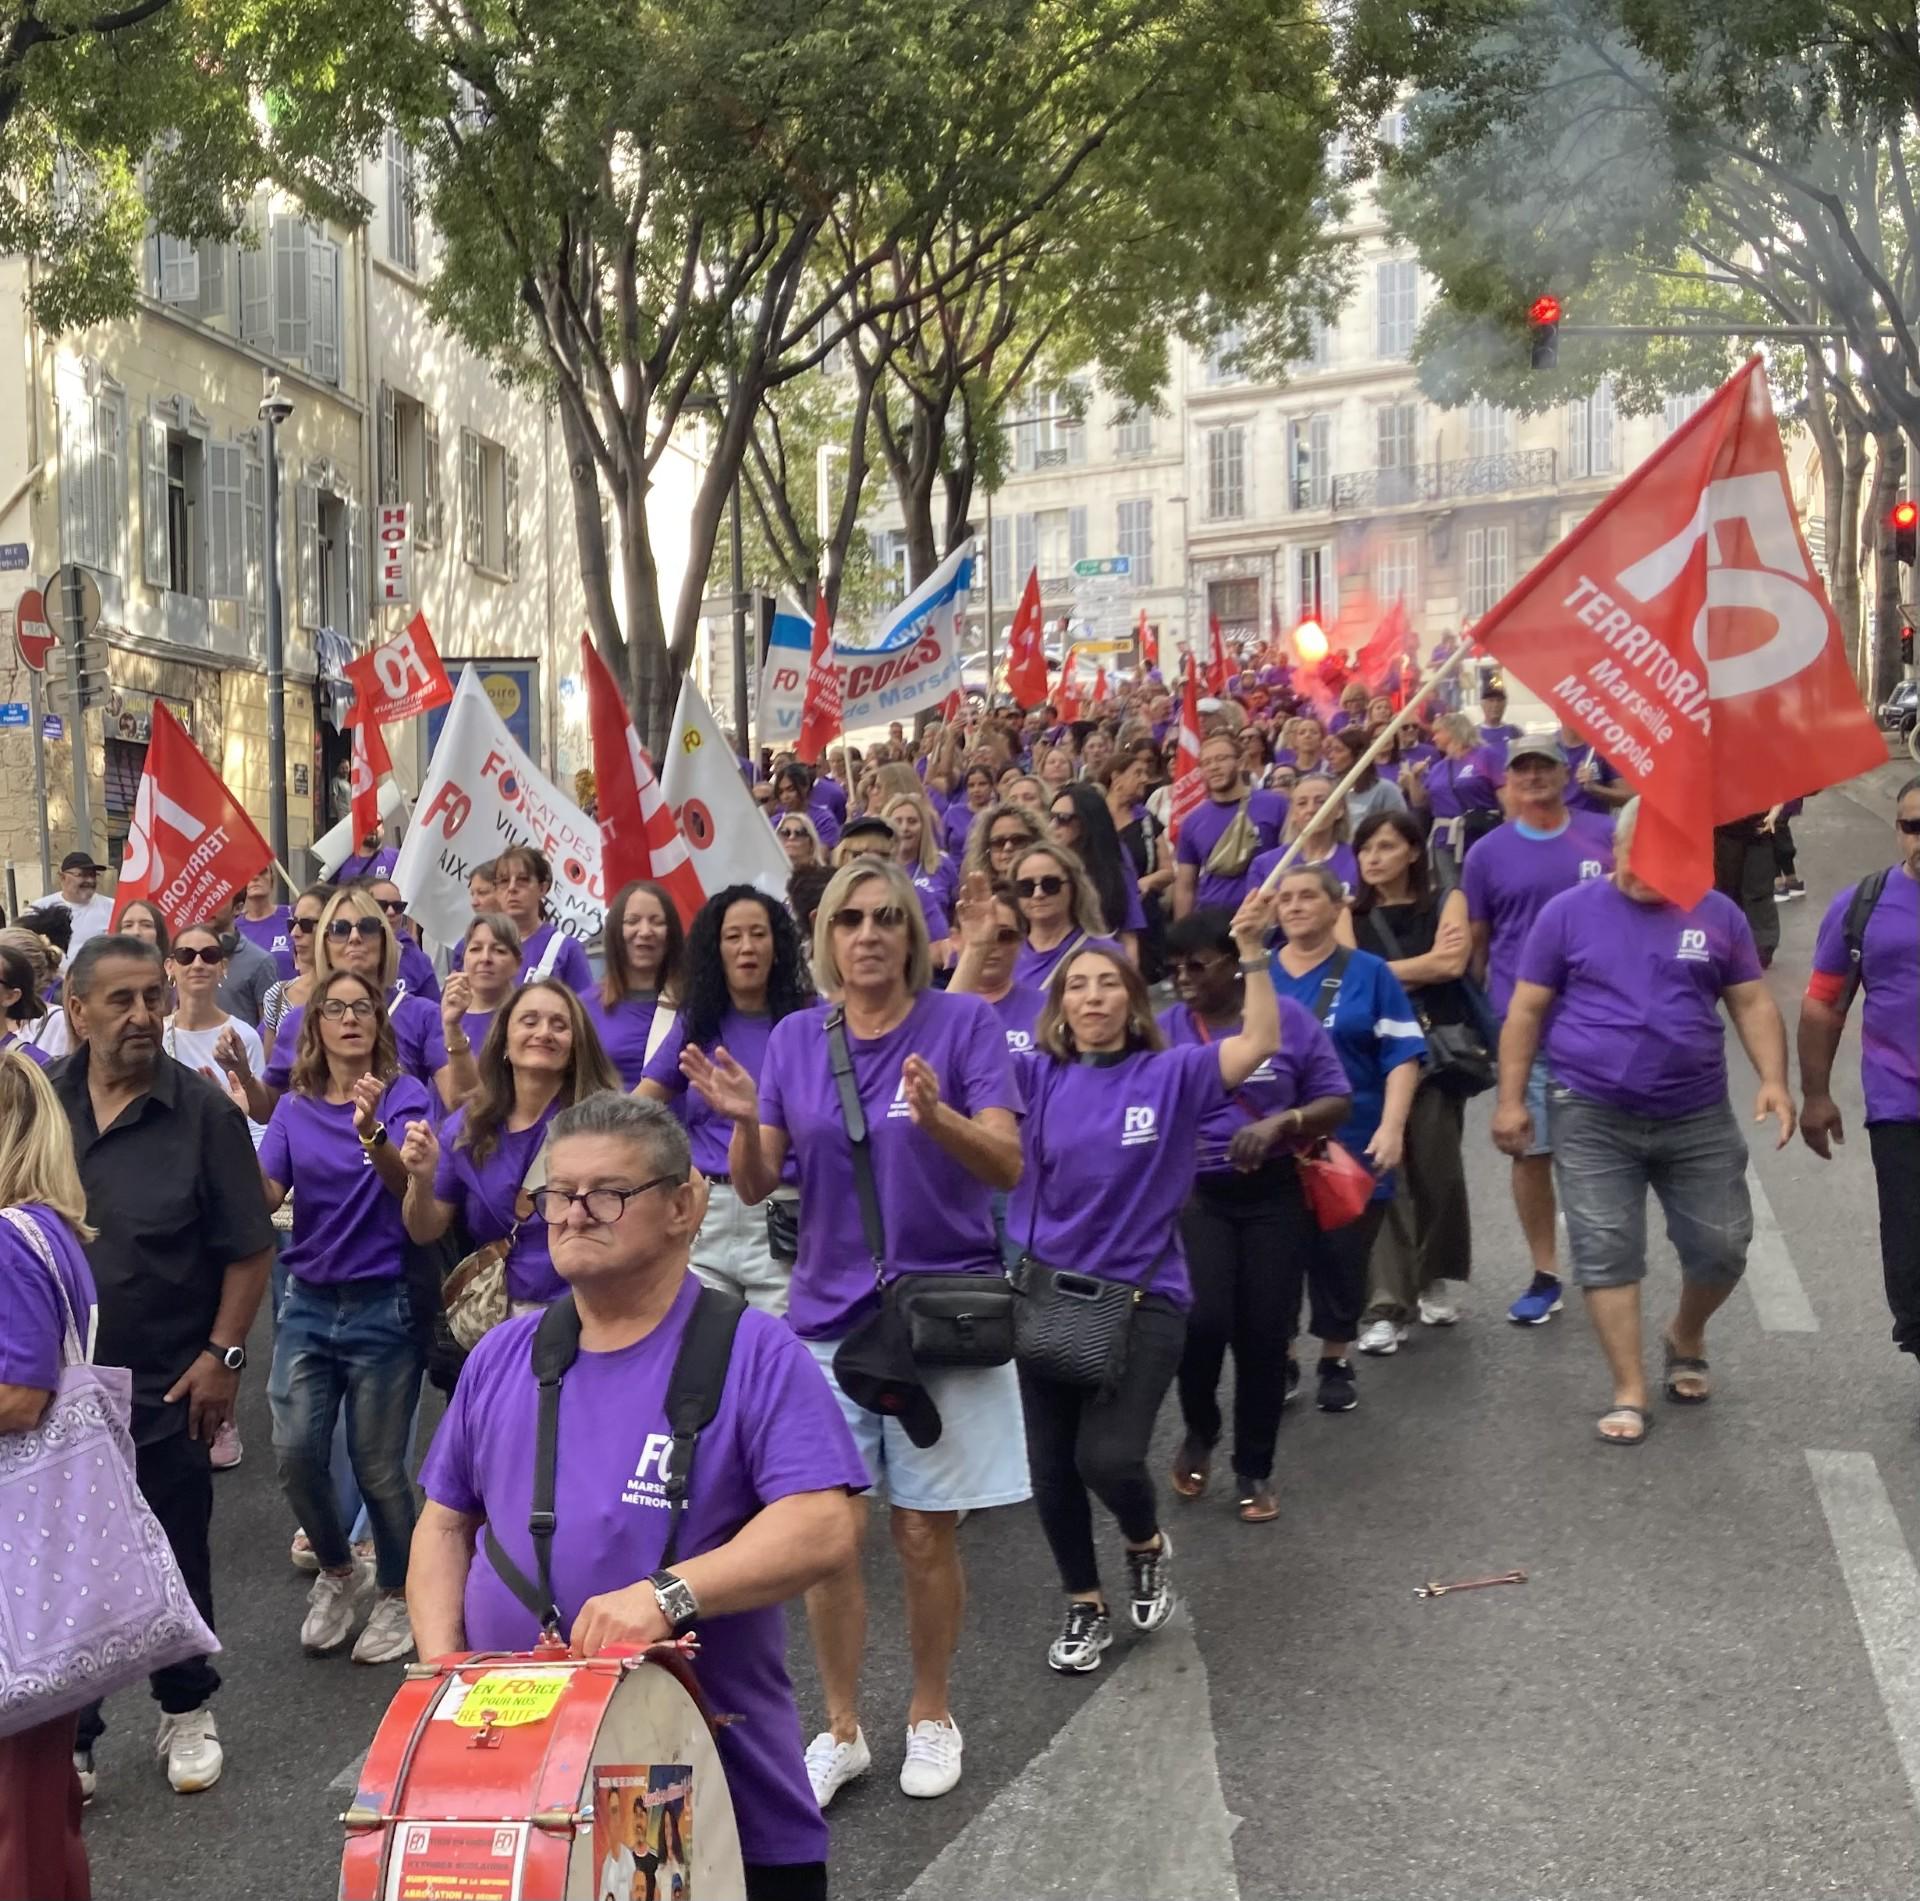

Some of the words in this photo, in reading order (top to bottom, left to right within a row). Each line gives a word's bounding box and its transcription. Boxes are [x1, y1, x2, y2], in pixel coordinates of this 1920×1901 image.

[382, 509, 405, 597] HOTEL
[772, 668, 799, 691] FO
[1587, 657, 1674, 744] Marseille
[1553, 675, 1655, 778] Métropole
[419, 780, 472, 841] FO
[558, 823, 595, 863] DES
[563, 857, 605, 901] OU
[1581, 861, 1602, 877] FO
[1681, 929, 1706, 949] FO
[1006, 1030, 1030, 1048] FO
[1125, 1106, 1156, 1131] FO
[627, 1479, 667, 1495] MARSE
[473, 1684, 496, 1695] EN
[480, 1696, 512, 1706] POUR
[512, 1696, 537, 1706] NOS
